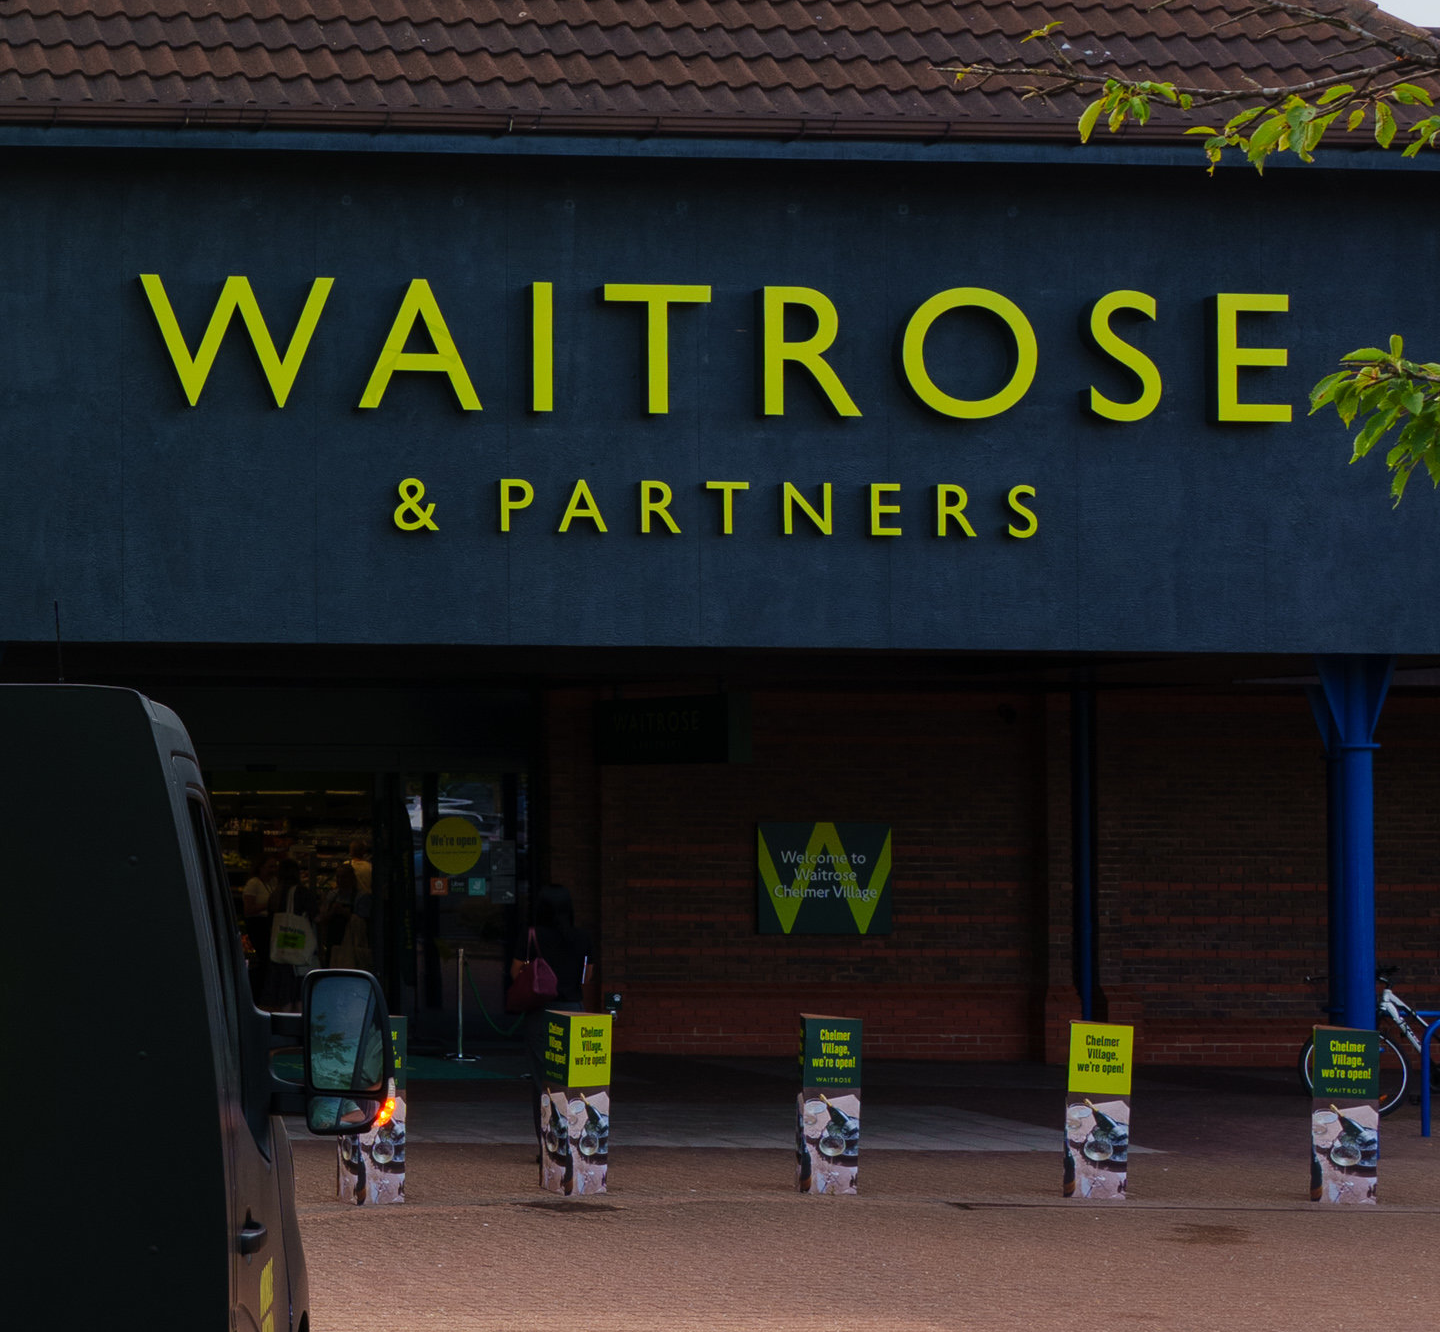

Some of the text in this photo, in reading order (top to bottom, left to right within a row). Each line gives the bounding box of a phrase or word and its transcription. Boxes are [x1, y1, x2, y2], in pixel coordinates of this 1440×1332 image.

[140, 273, 1293, 423] WAITROSE
[392, 478, 1040, 539] & PARTNERS
[780, 850, 866, 864] Welcome to
[794, 868, 857, 881] Waitrose
[774, 884, 878, 902] Chelmer Village
[580, 1027, 604, 1037] Chelmer
[820, 1029, 851, 1041] Chelmer
[1085, 1034, 1120, 1047] Chelmer
[1330, 1040, 1366, 1052] Chelmer
[822, 1042, 851, 1057] Village,
[1088, 1048, 1119, 1062] Village,
[812, 1055, 856, 1070] we're open!
[1332, 1053, 1365, 1068] Village,
[1077, 1061, 1125, 1075] we're open!
[1321, 1066, 1372, 1082] we're open!
